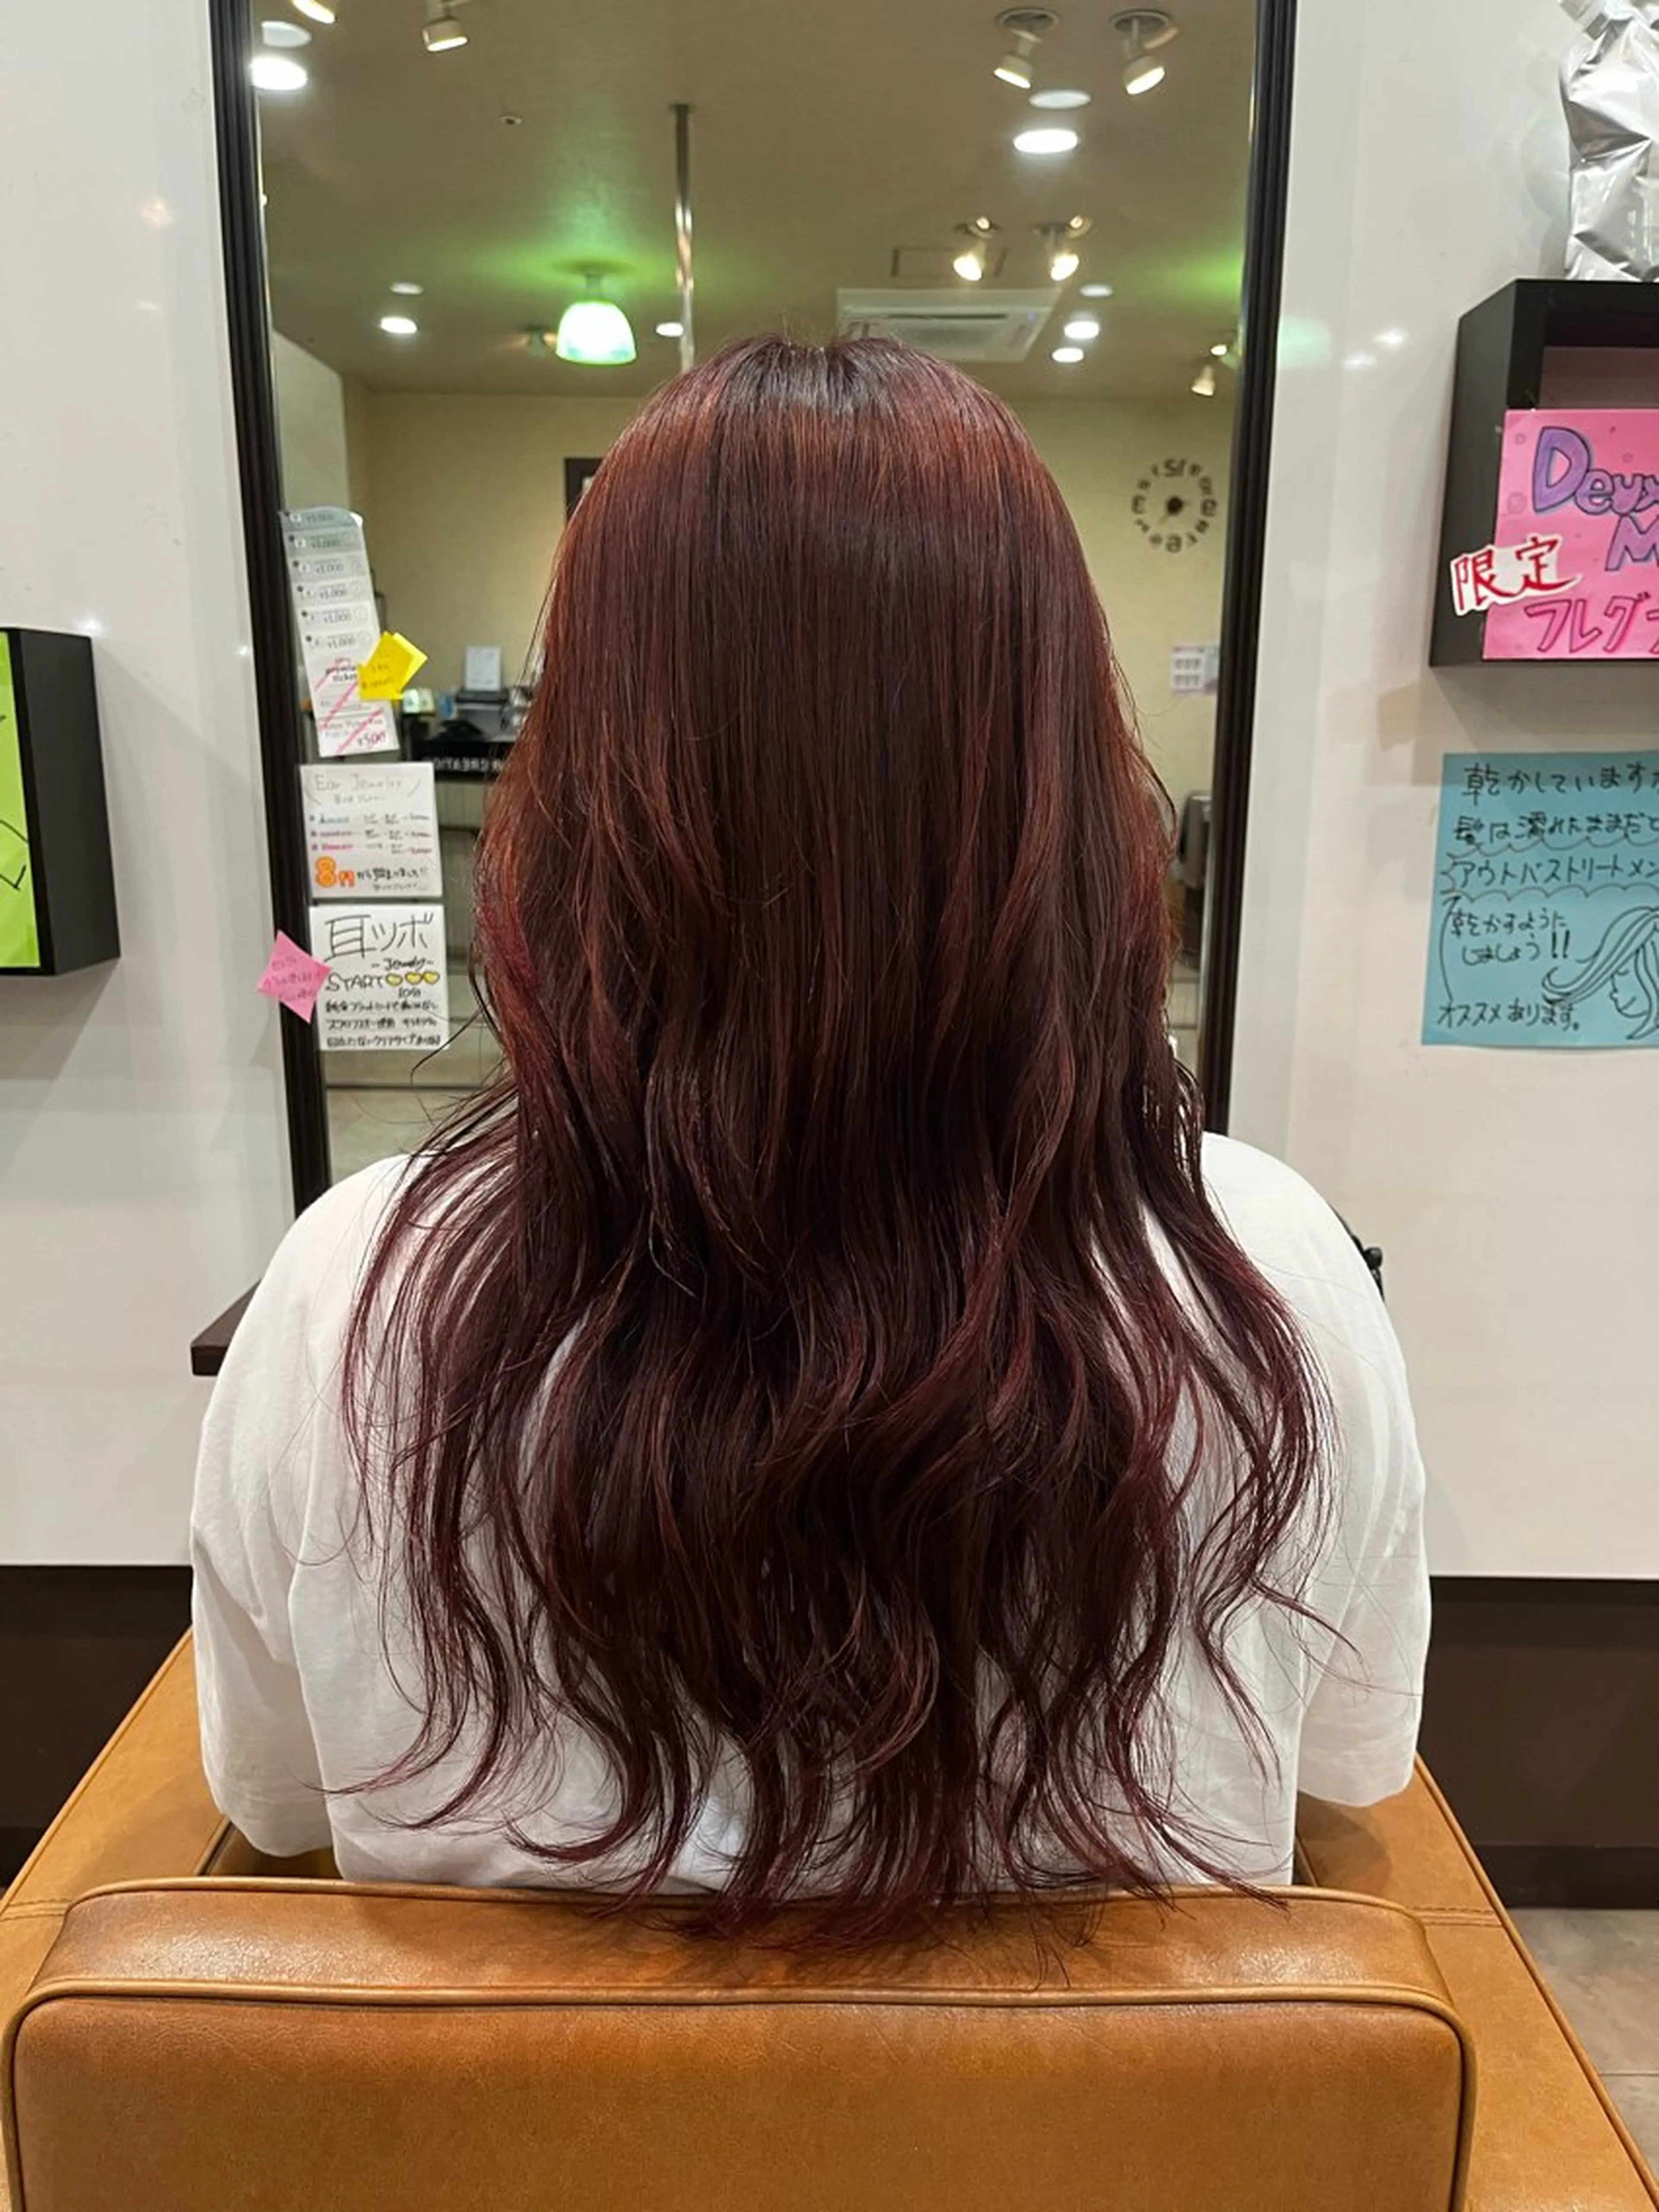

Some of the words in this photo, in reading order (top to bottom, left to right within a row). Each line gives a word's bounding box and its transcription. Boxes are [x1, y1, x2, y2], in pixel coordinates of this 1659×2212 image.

[1454, 536, 1577, 611] 限定
[323, 912, 434, 963] 耳ツボ
[325, 972, 383, 991] START
